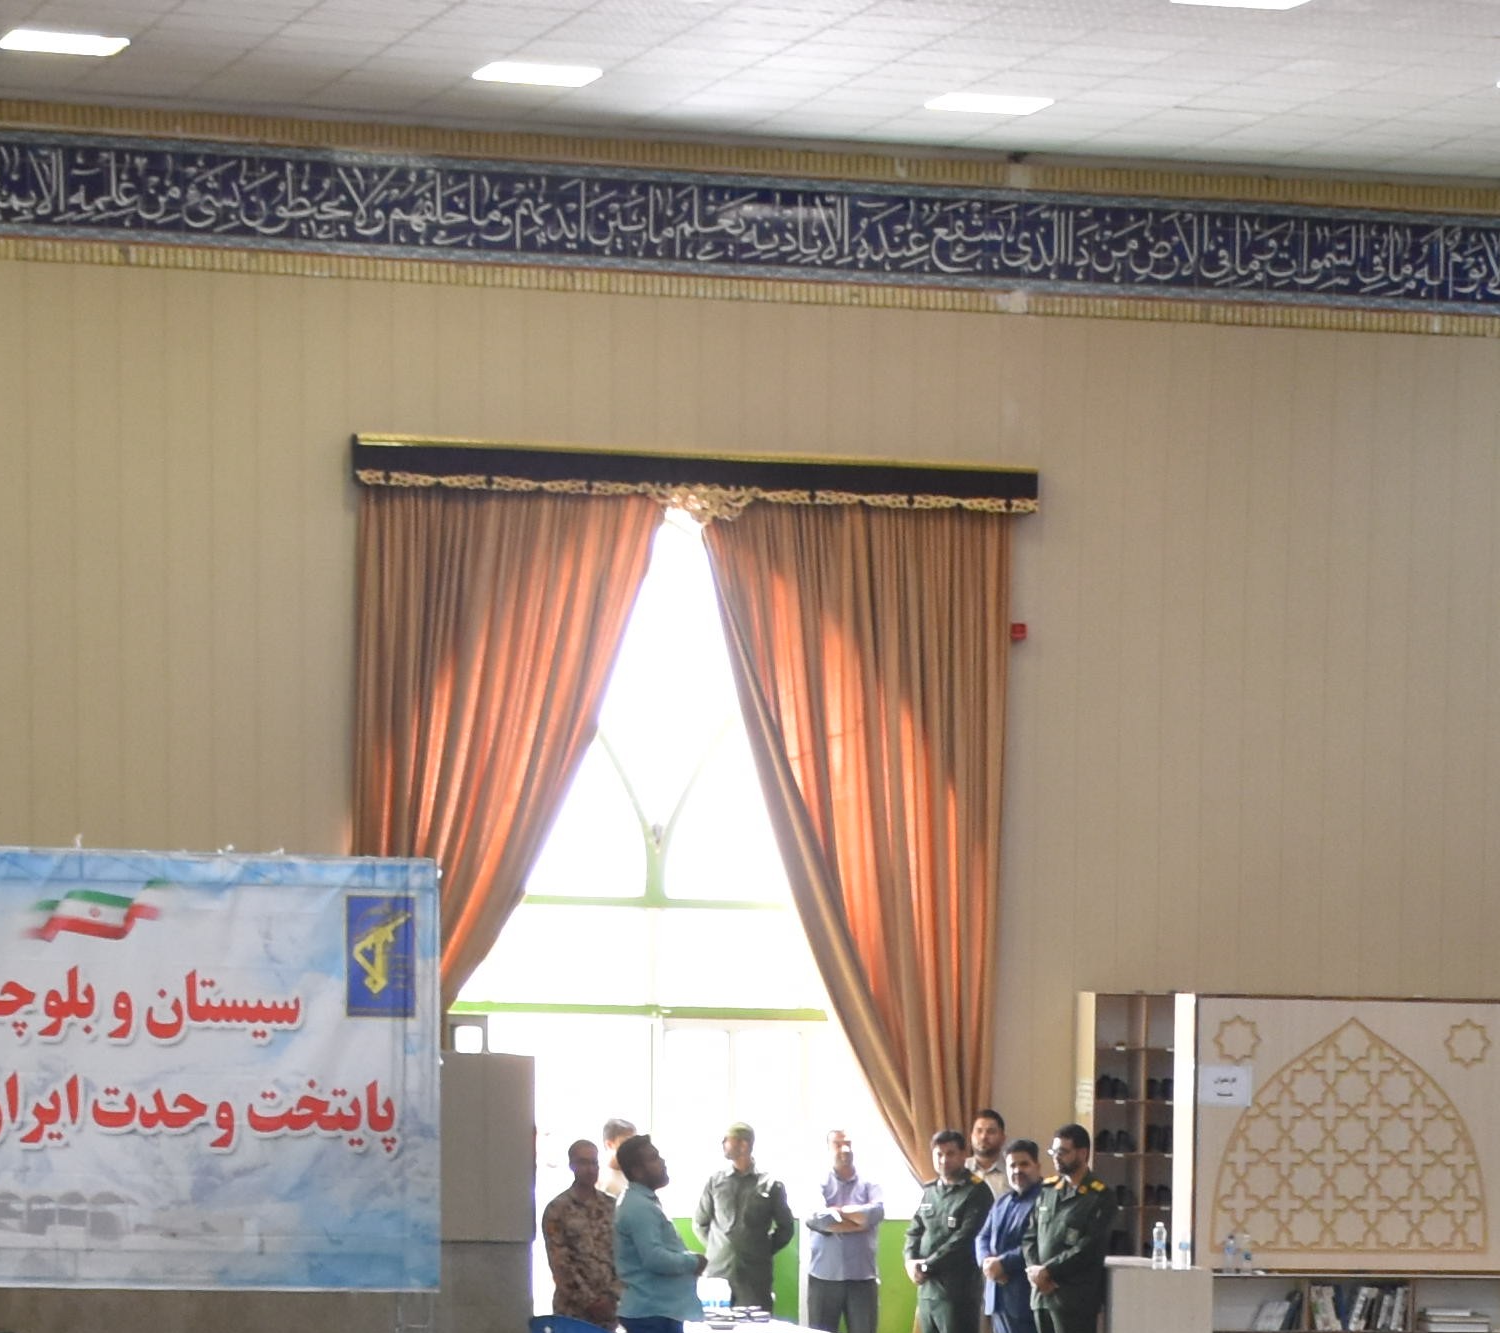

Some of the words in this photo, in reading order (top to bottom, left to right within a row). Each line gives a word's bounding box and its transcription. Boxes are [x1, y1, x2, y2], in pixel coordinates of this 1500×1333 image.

[110, 993, 134, 1039] و
[144, 970, 301, 1043] سیستان
[91, 1086, 233, 1149] وحدت
[246, 1079, 397, 1154] پایتخت
